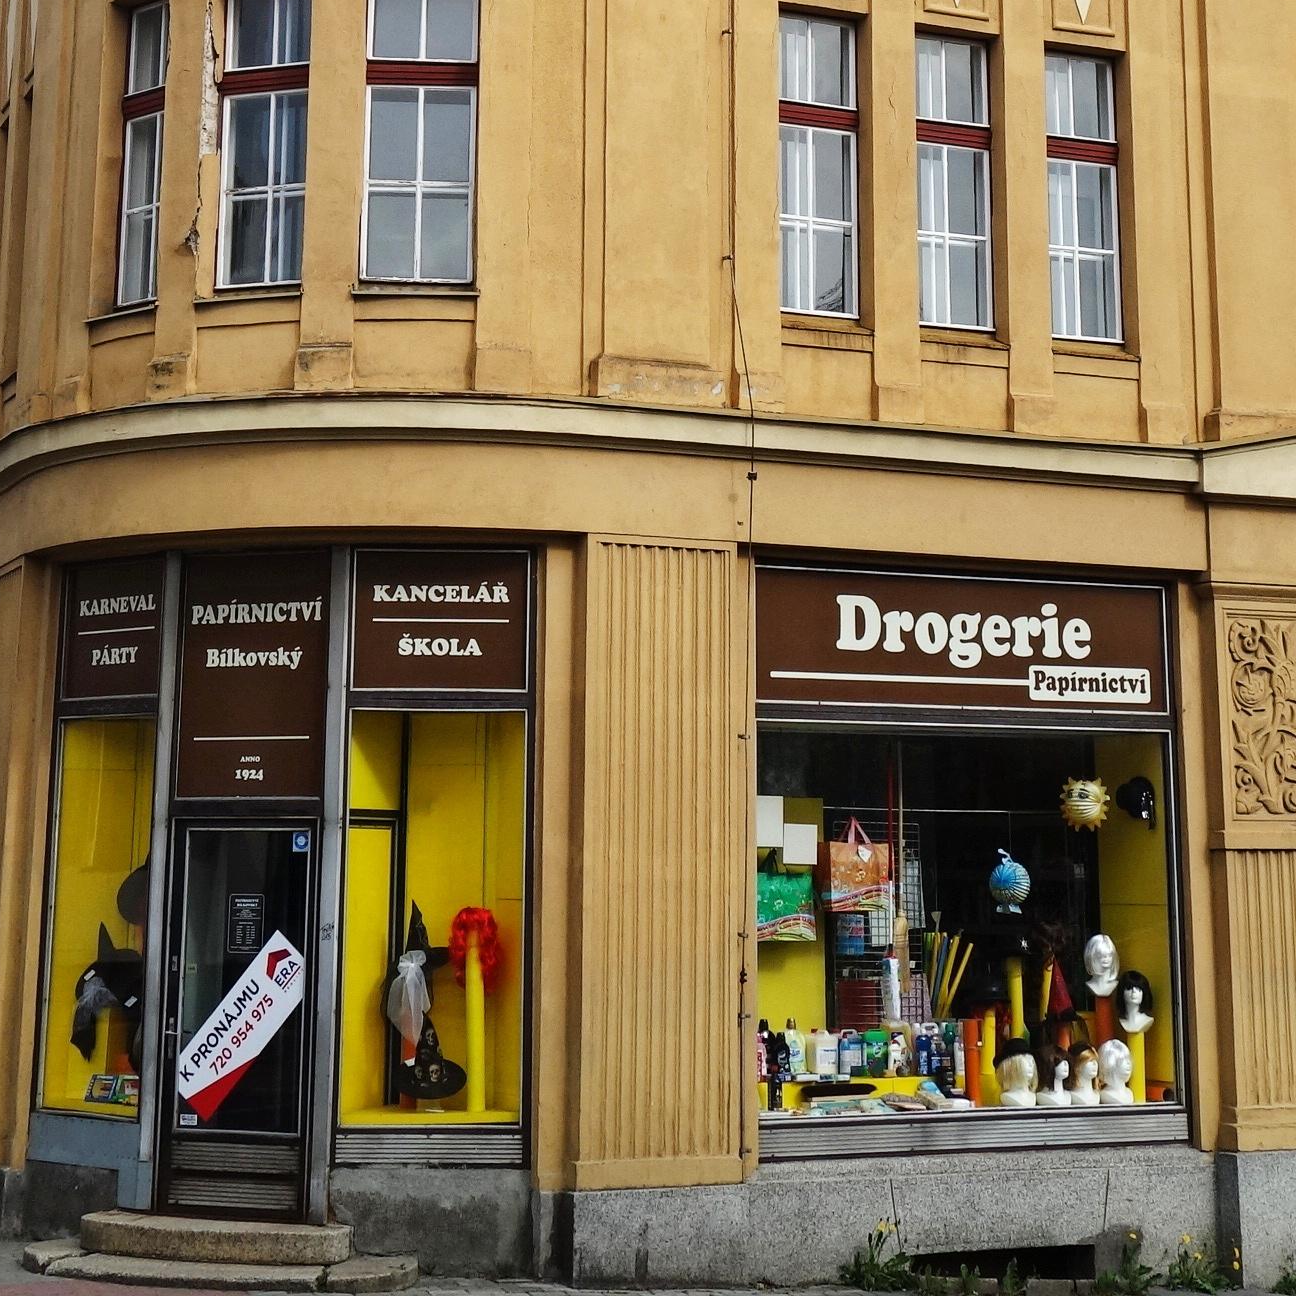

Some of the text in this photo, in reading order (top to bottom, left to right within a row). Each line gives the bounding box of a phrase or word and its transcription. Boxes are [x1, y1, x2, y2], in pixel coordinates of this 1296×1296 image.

[373, 581, 510, 603] KANCELÁŘ
[79, 593, 157, 617] KARNEVAL
[191, 596, 323, 624] PAPÍRNICTVÍ
[835, 594, 1092, 669] Drogerie
[91, 644, 139, 666] PÁRTY
[398, 633, 483, 656] ŠKOLA
[206, 646, 303, 670] Bílkovský
[1033, 669, 1147, 696] Papírnictví
[239, 755, 261, 763] ANNO
[235, 768, 264, 781] 1924
[274, 960, 299, 987] ERA
[179, 1065, 194, 1082] K
[190, 978, 260, 1068] PRONÁJMU
[209, 993, 274, 1075] 720 954 975
